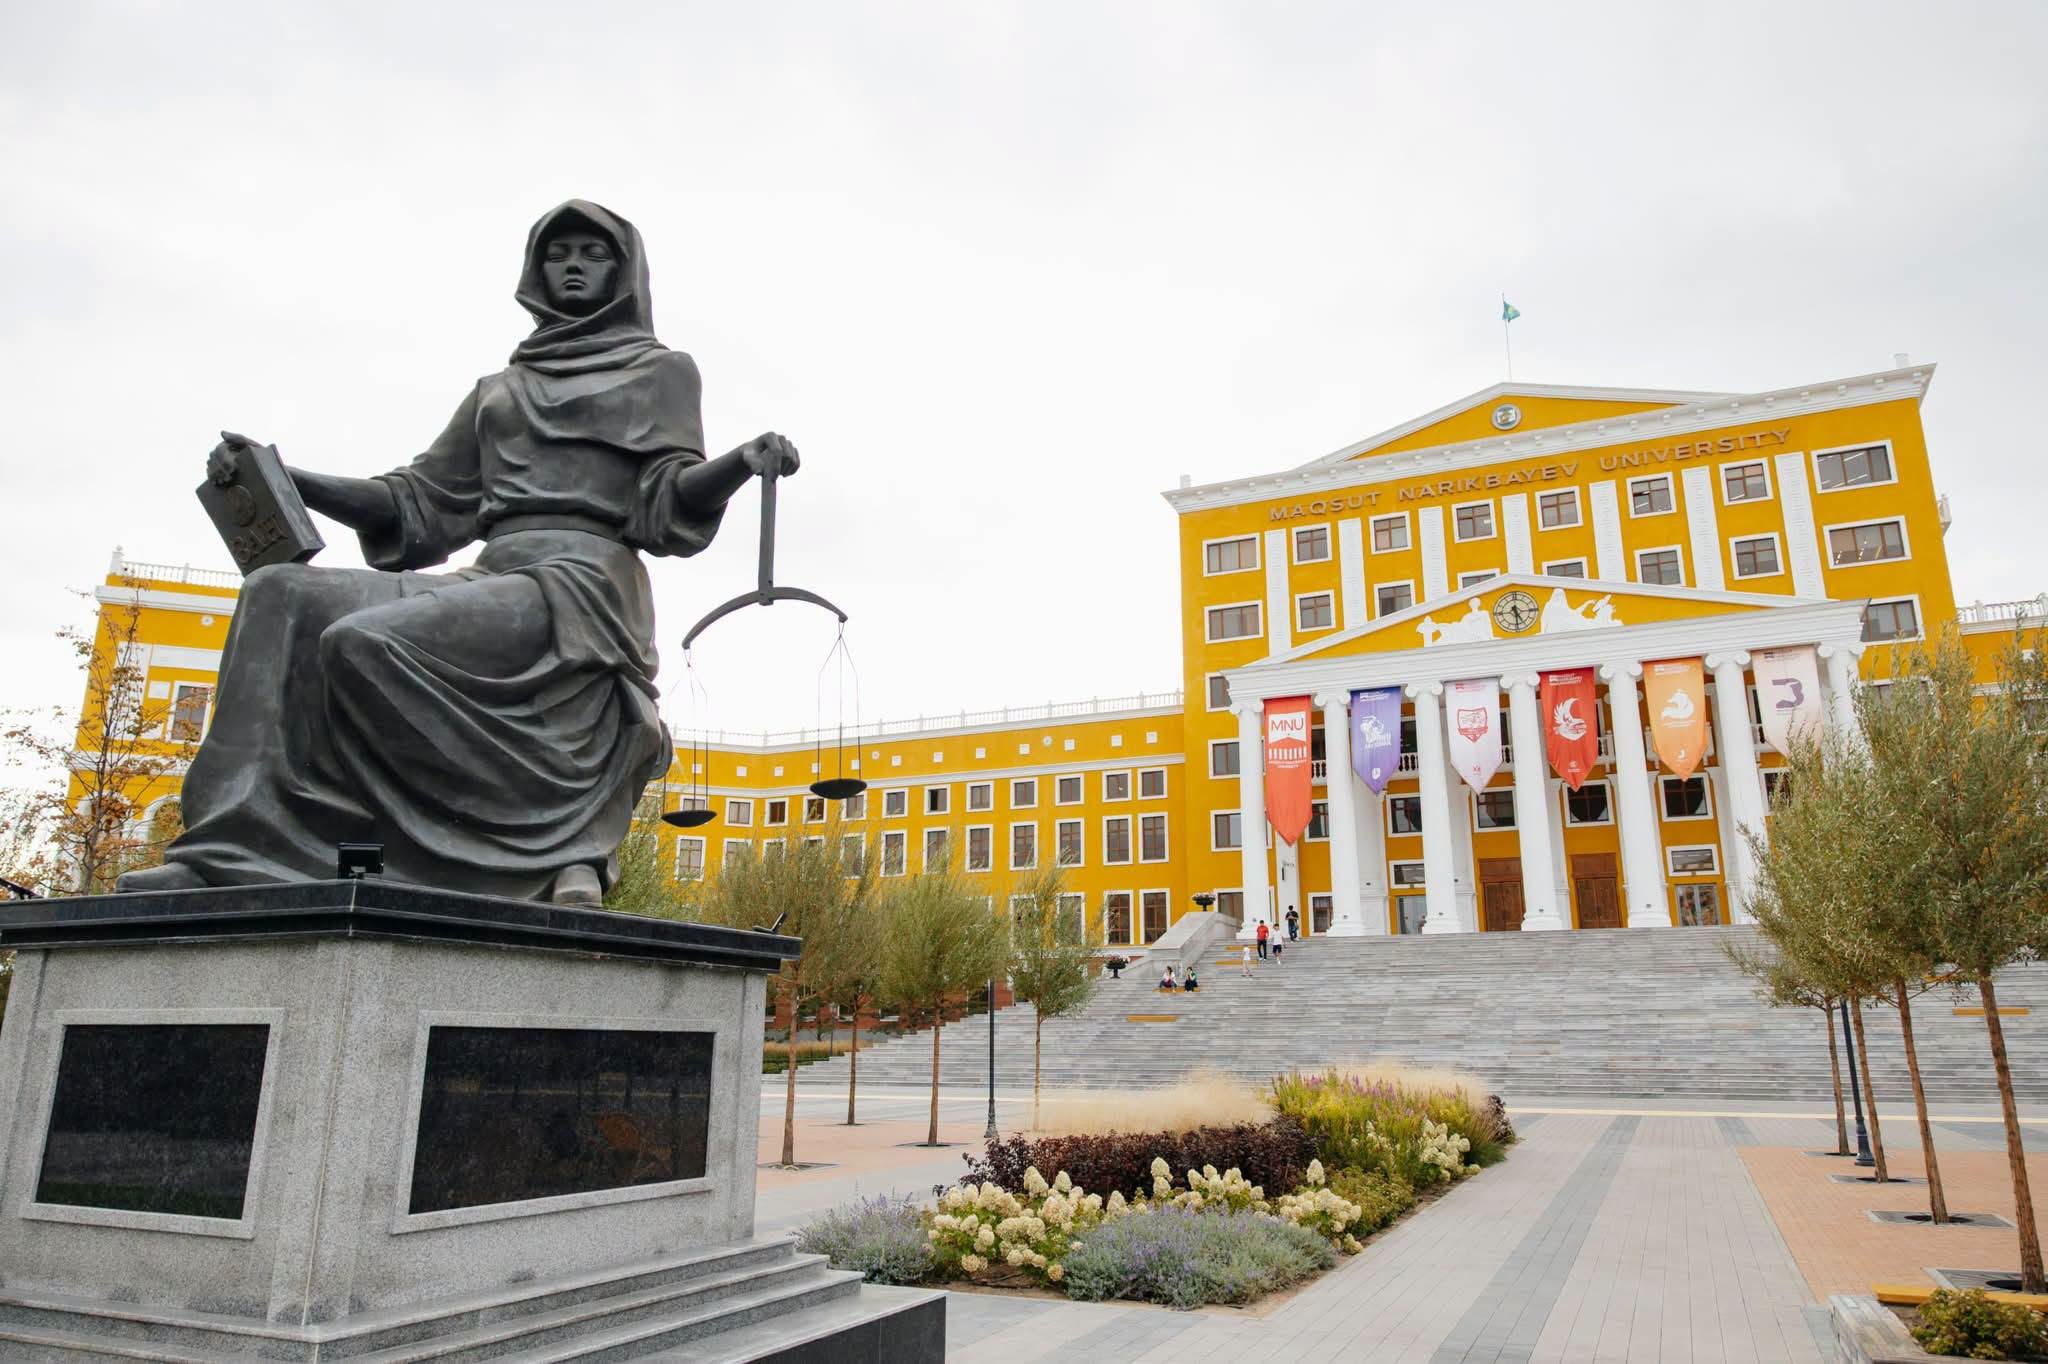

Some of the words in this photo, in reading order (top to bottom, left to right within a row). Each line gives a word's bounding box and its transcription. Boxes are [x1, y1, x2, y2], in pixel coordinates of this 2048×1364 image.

[1269, 490, 1382, 521] MAQSUT
[1399, 462, 1579, 502] NARIKBAYEV
[1600, 428, 1791, 471] UNIVERSITY
[1271, 717, 1304, 731] MNU
